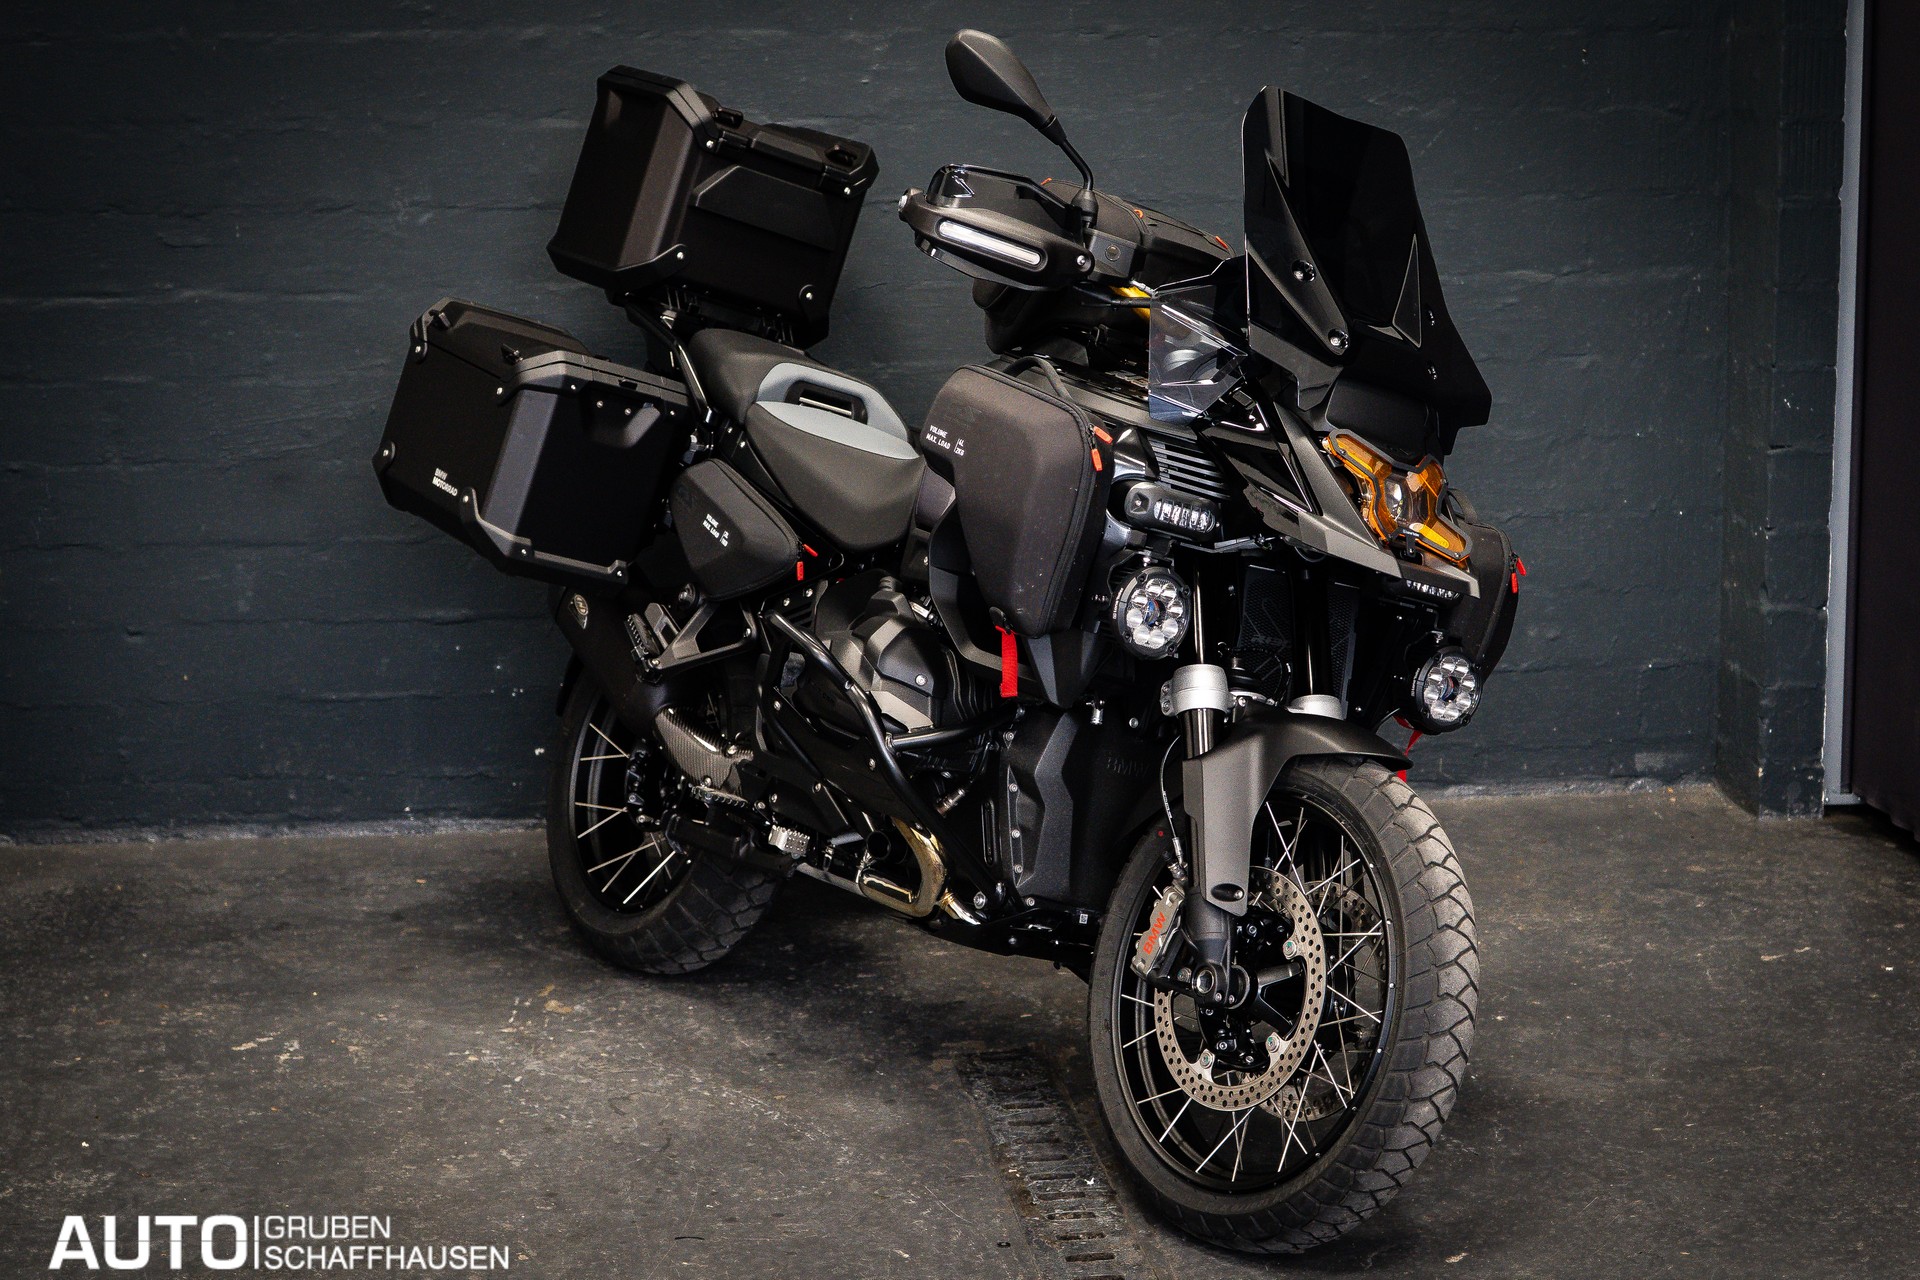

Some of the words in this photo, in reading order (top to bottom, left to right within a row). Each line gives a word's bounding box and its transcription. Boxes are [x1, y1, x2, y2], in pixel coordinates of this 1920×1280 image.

[929, 425, 948, 438] VOLUME
[938, 439, 951, 449] LOAD
[432, 476, 458, 496] MOTORRAD
[1143, 911, 1166, 955] BMW
